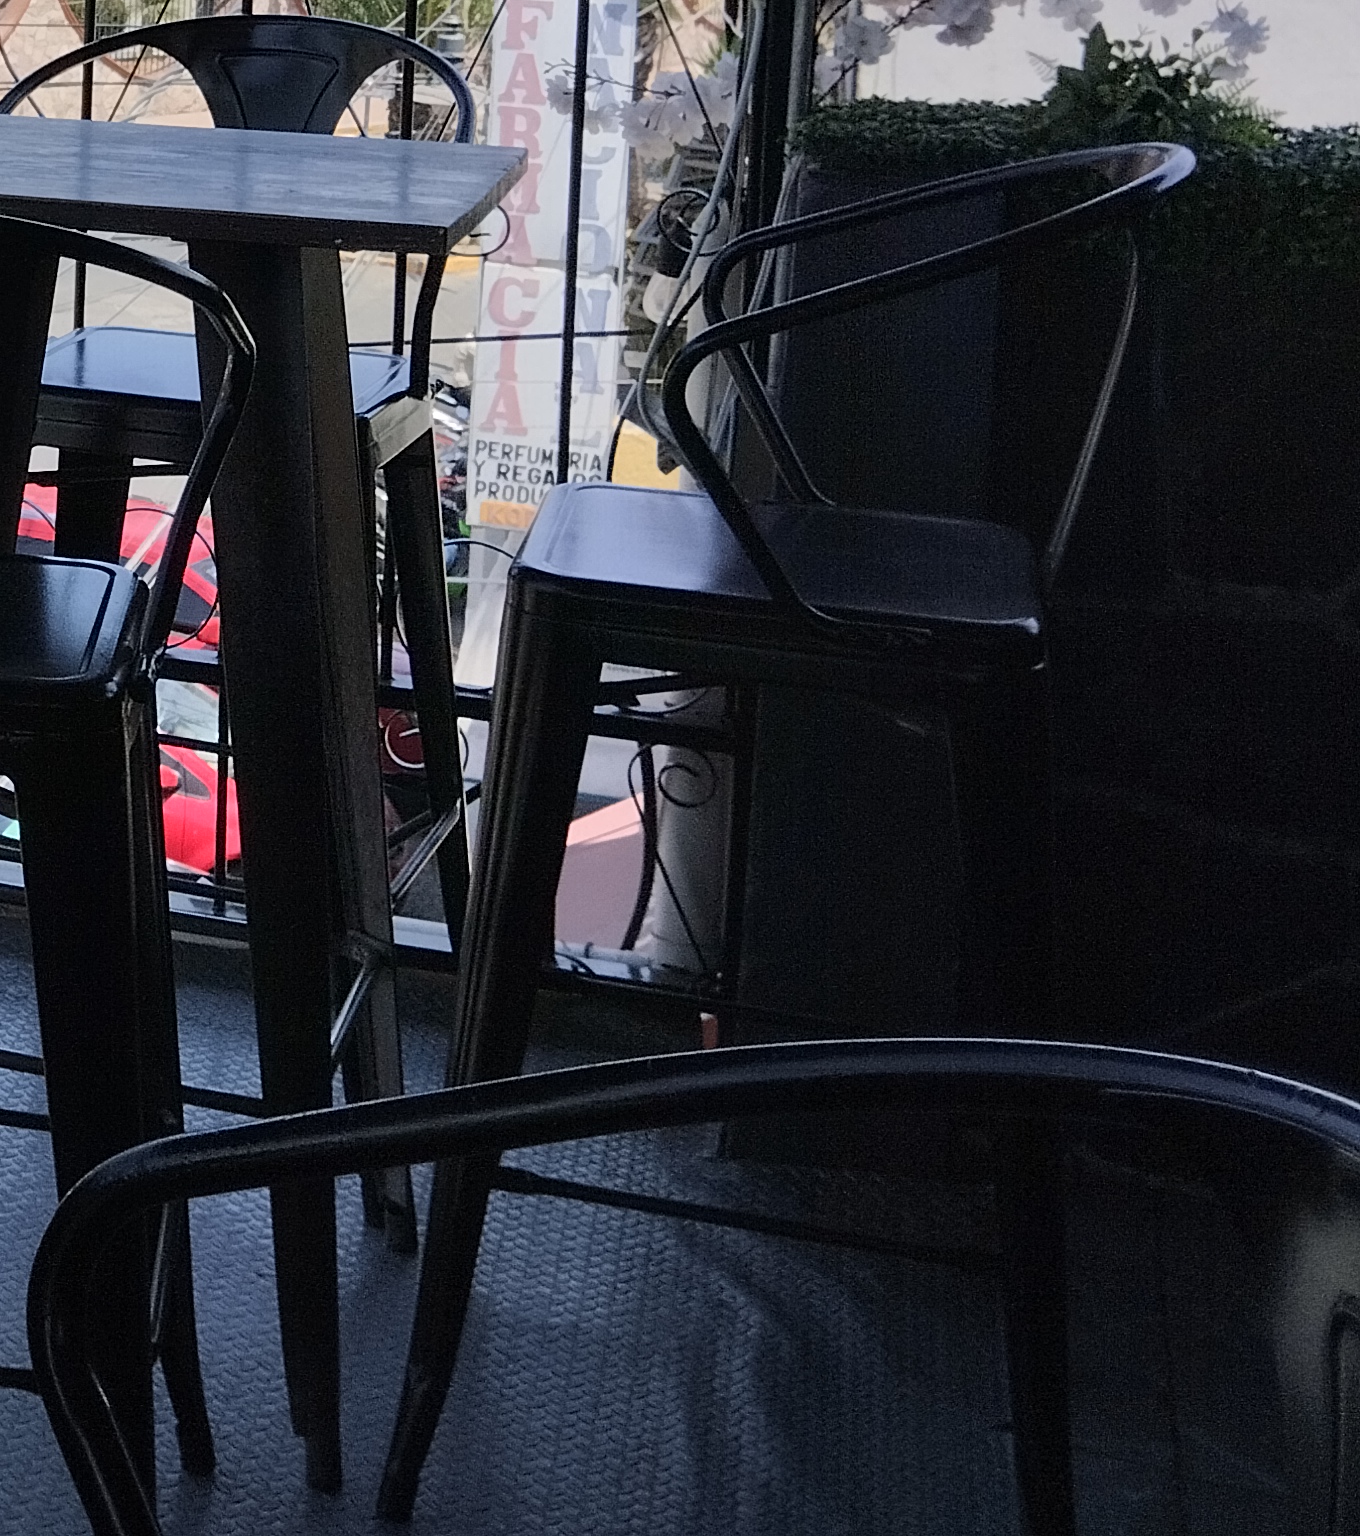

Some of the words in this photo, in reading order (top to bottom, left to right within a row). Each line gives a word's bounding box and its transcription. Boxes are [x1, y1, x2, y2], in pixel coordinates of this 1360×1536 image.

[473, 459, 486, 478] Y
[474, 439, 602, 472] PERFUMRIA
[474, 479, 545, 505] PRODU
